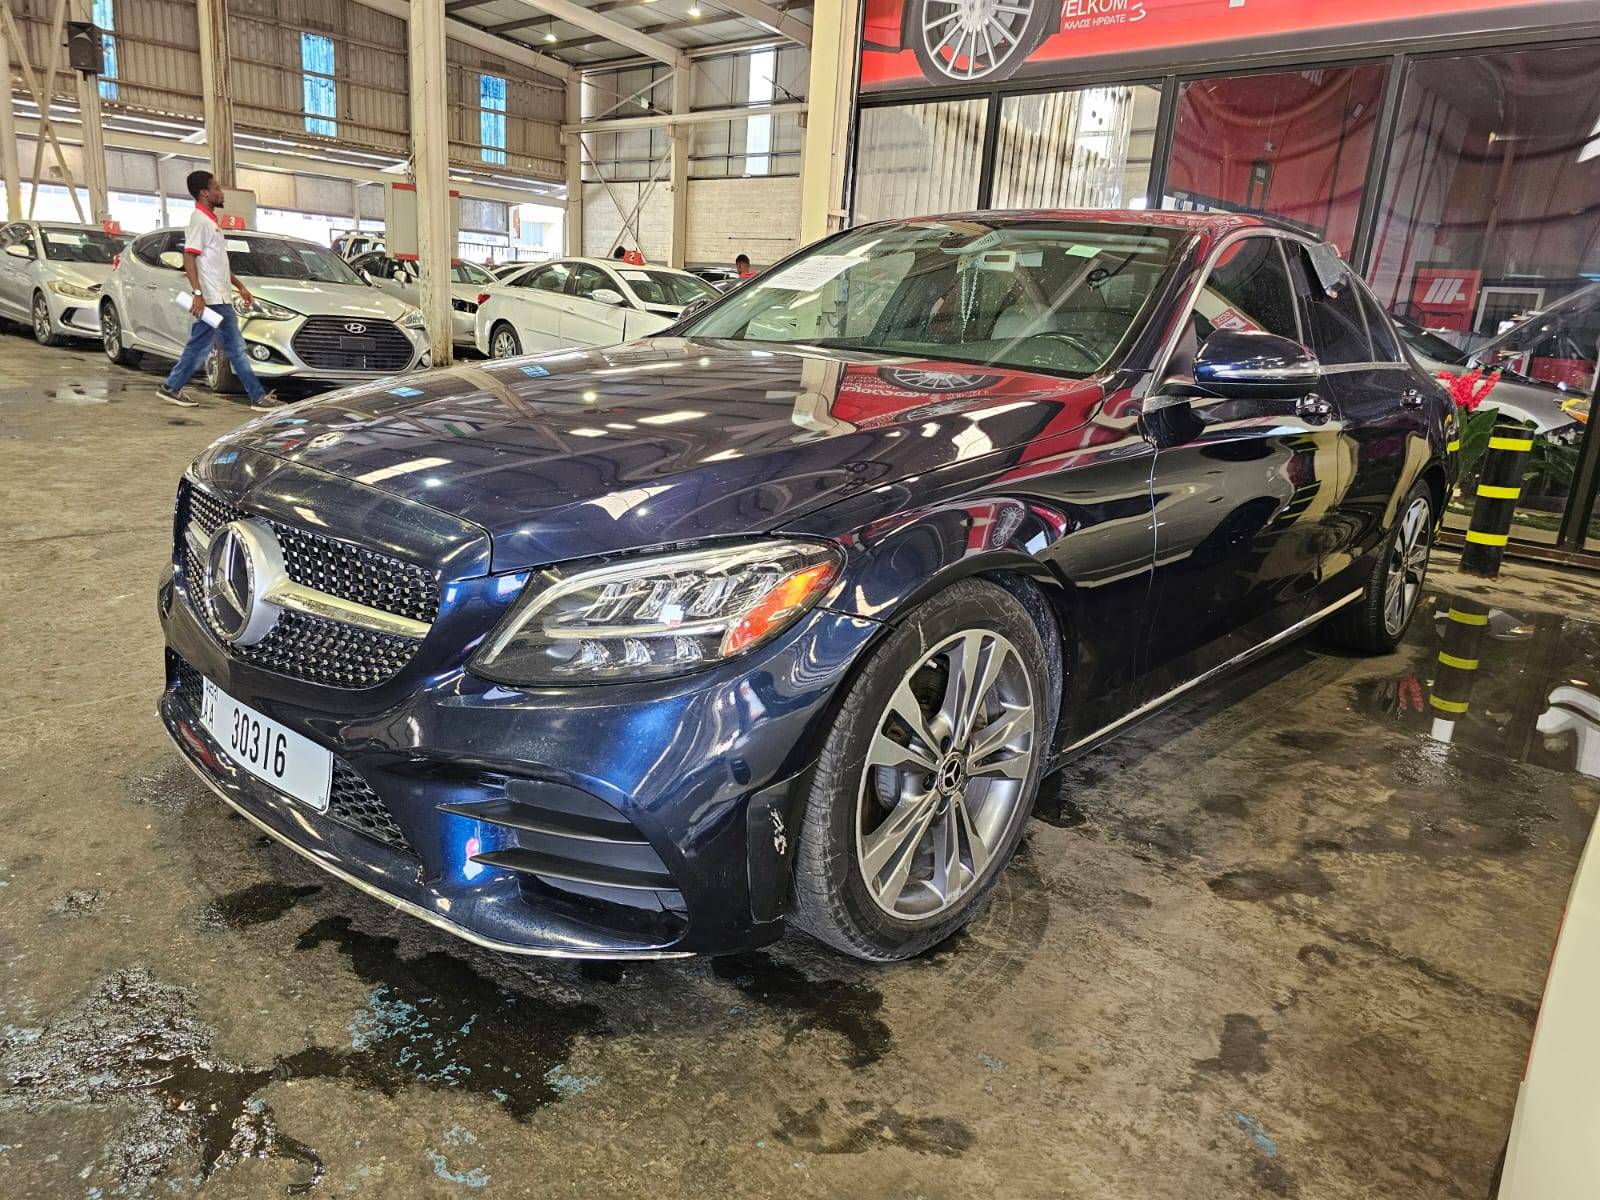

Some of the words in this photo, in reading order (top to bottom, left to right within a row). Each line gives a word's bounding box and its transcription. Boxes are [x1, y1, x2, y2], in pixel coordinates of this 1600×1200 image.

[1061, 0, 1127, 17] ELKOM
[229, 216, 235, 226] 3
[629, 251, 635, 261] 2
[231, 707, 287, 778] 30316
